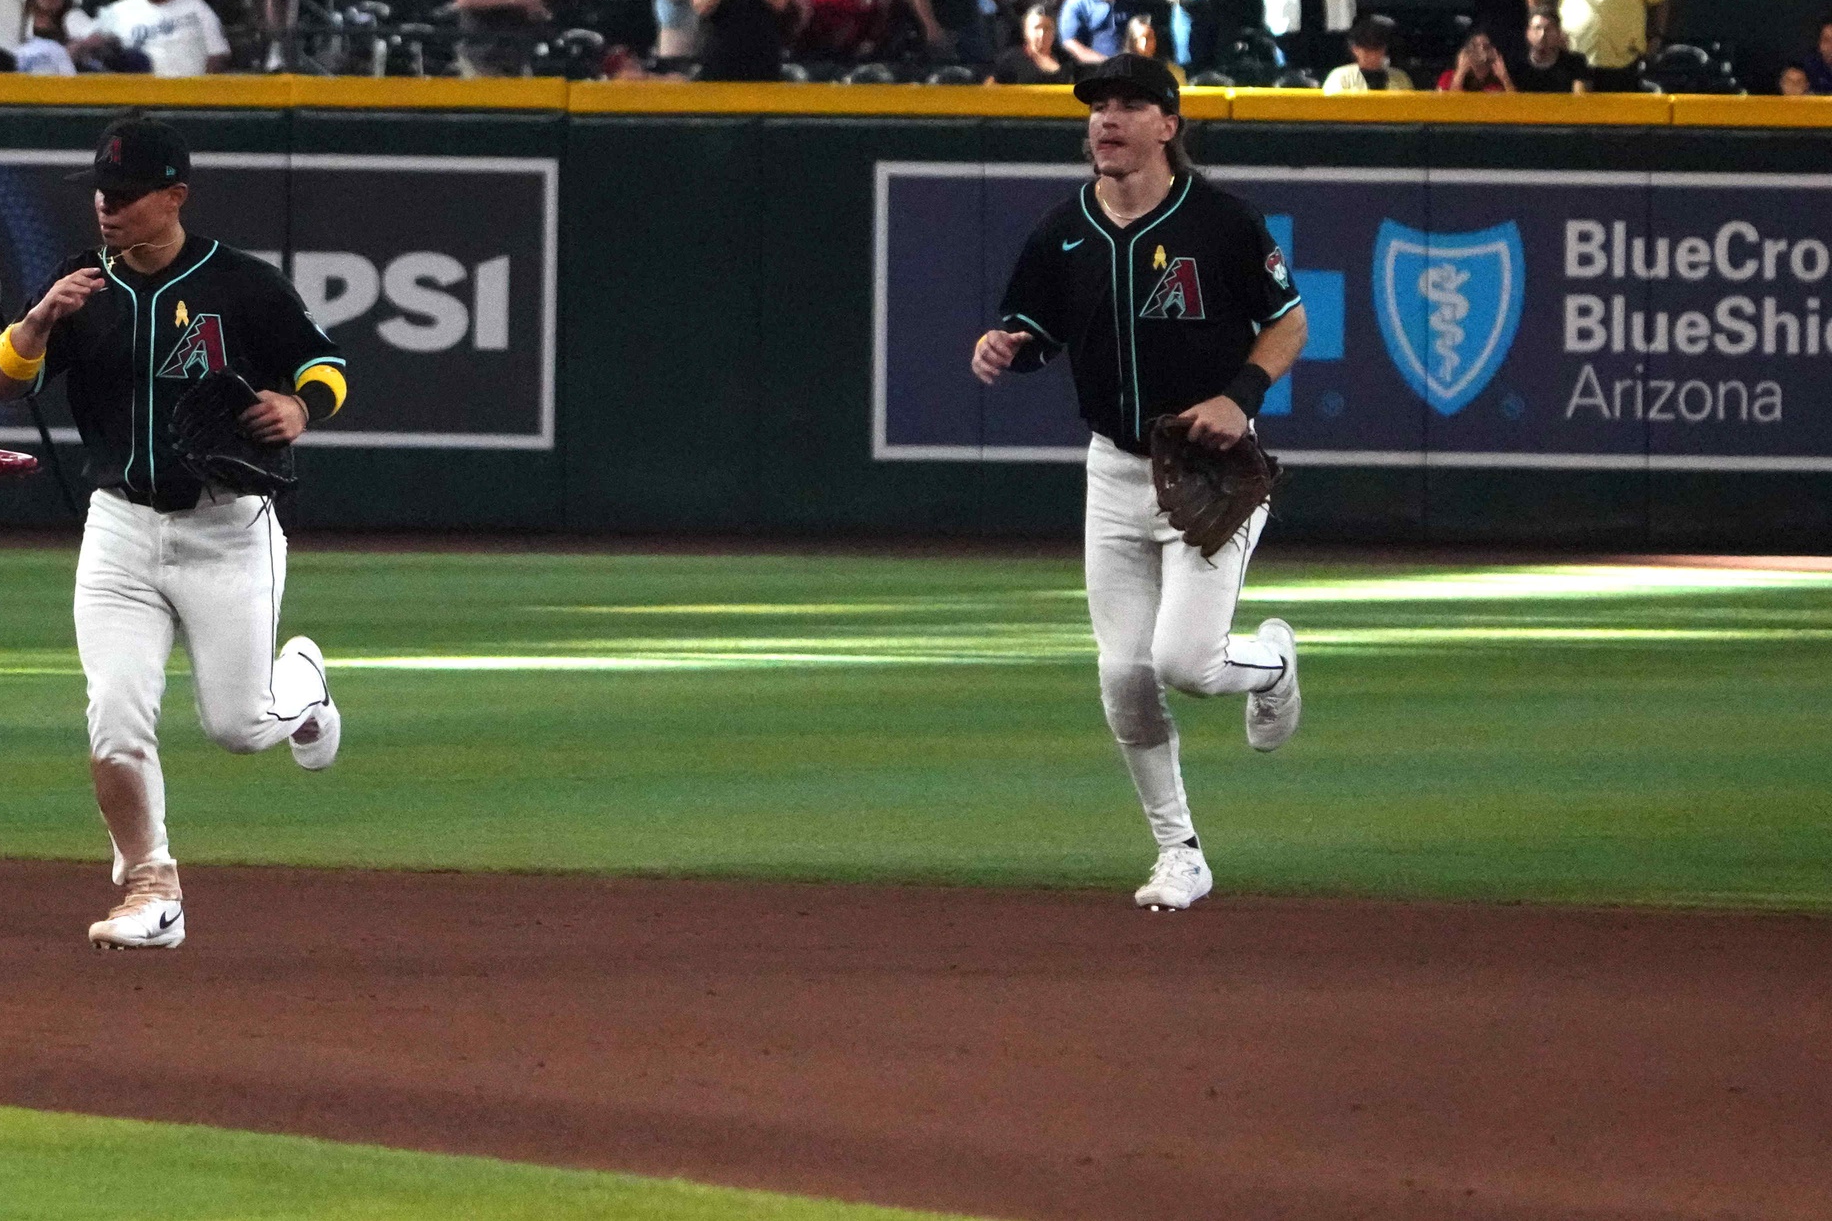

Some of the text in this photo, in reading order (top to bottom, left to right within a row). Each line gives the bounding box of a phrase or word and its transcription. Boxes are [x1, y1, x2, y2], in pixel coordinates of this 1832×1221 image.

[1564, 219, 1830, 281] BlueCro
[243, 250, 511, 352] PSI
[1564, 293, 1832, 355] BlueShi
[1567, 363, 1783, 421] Arizona
